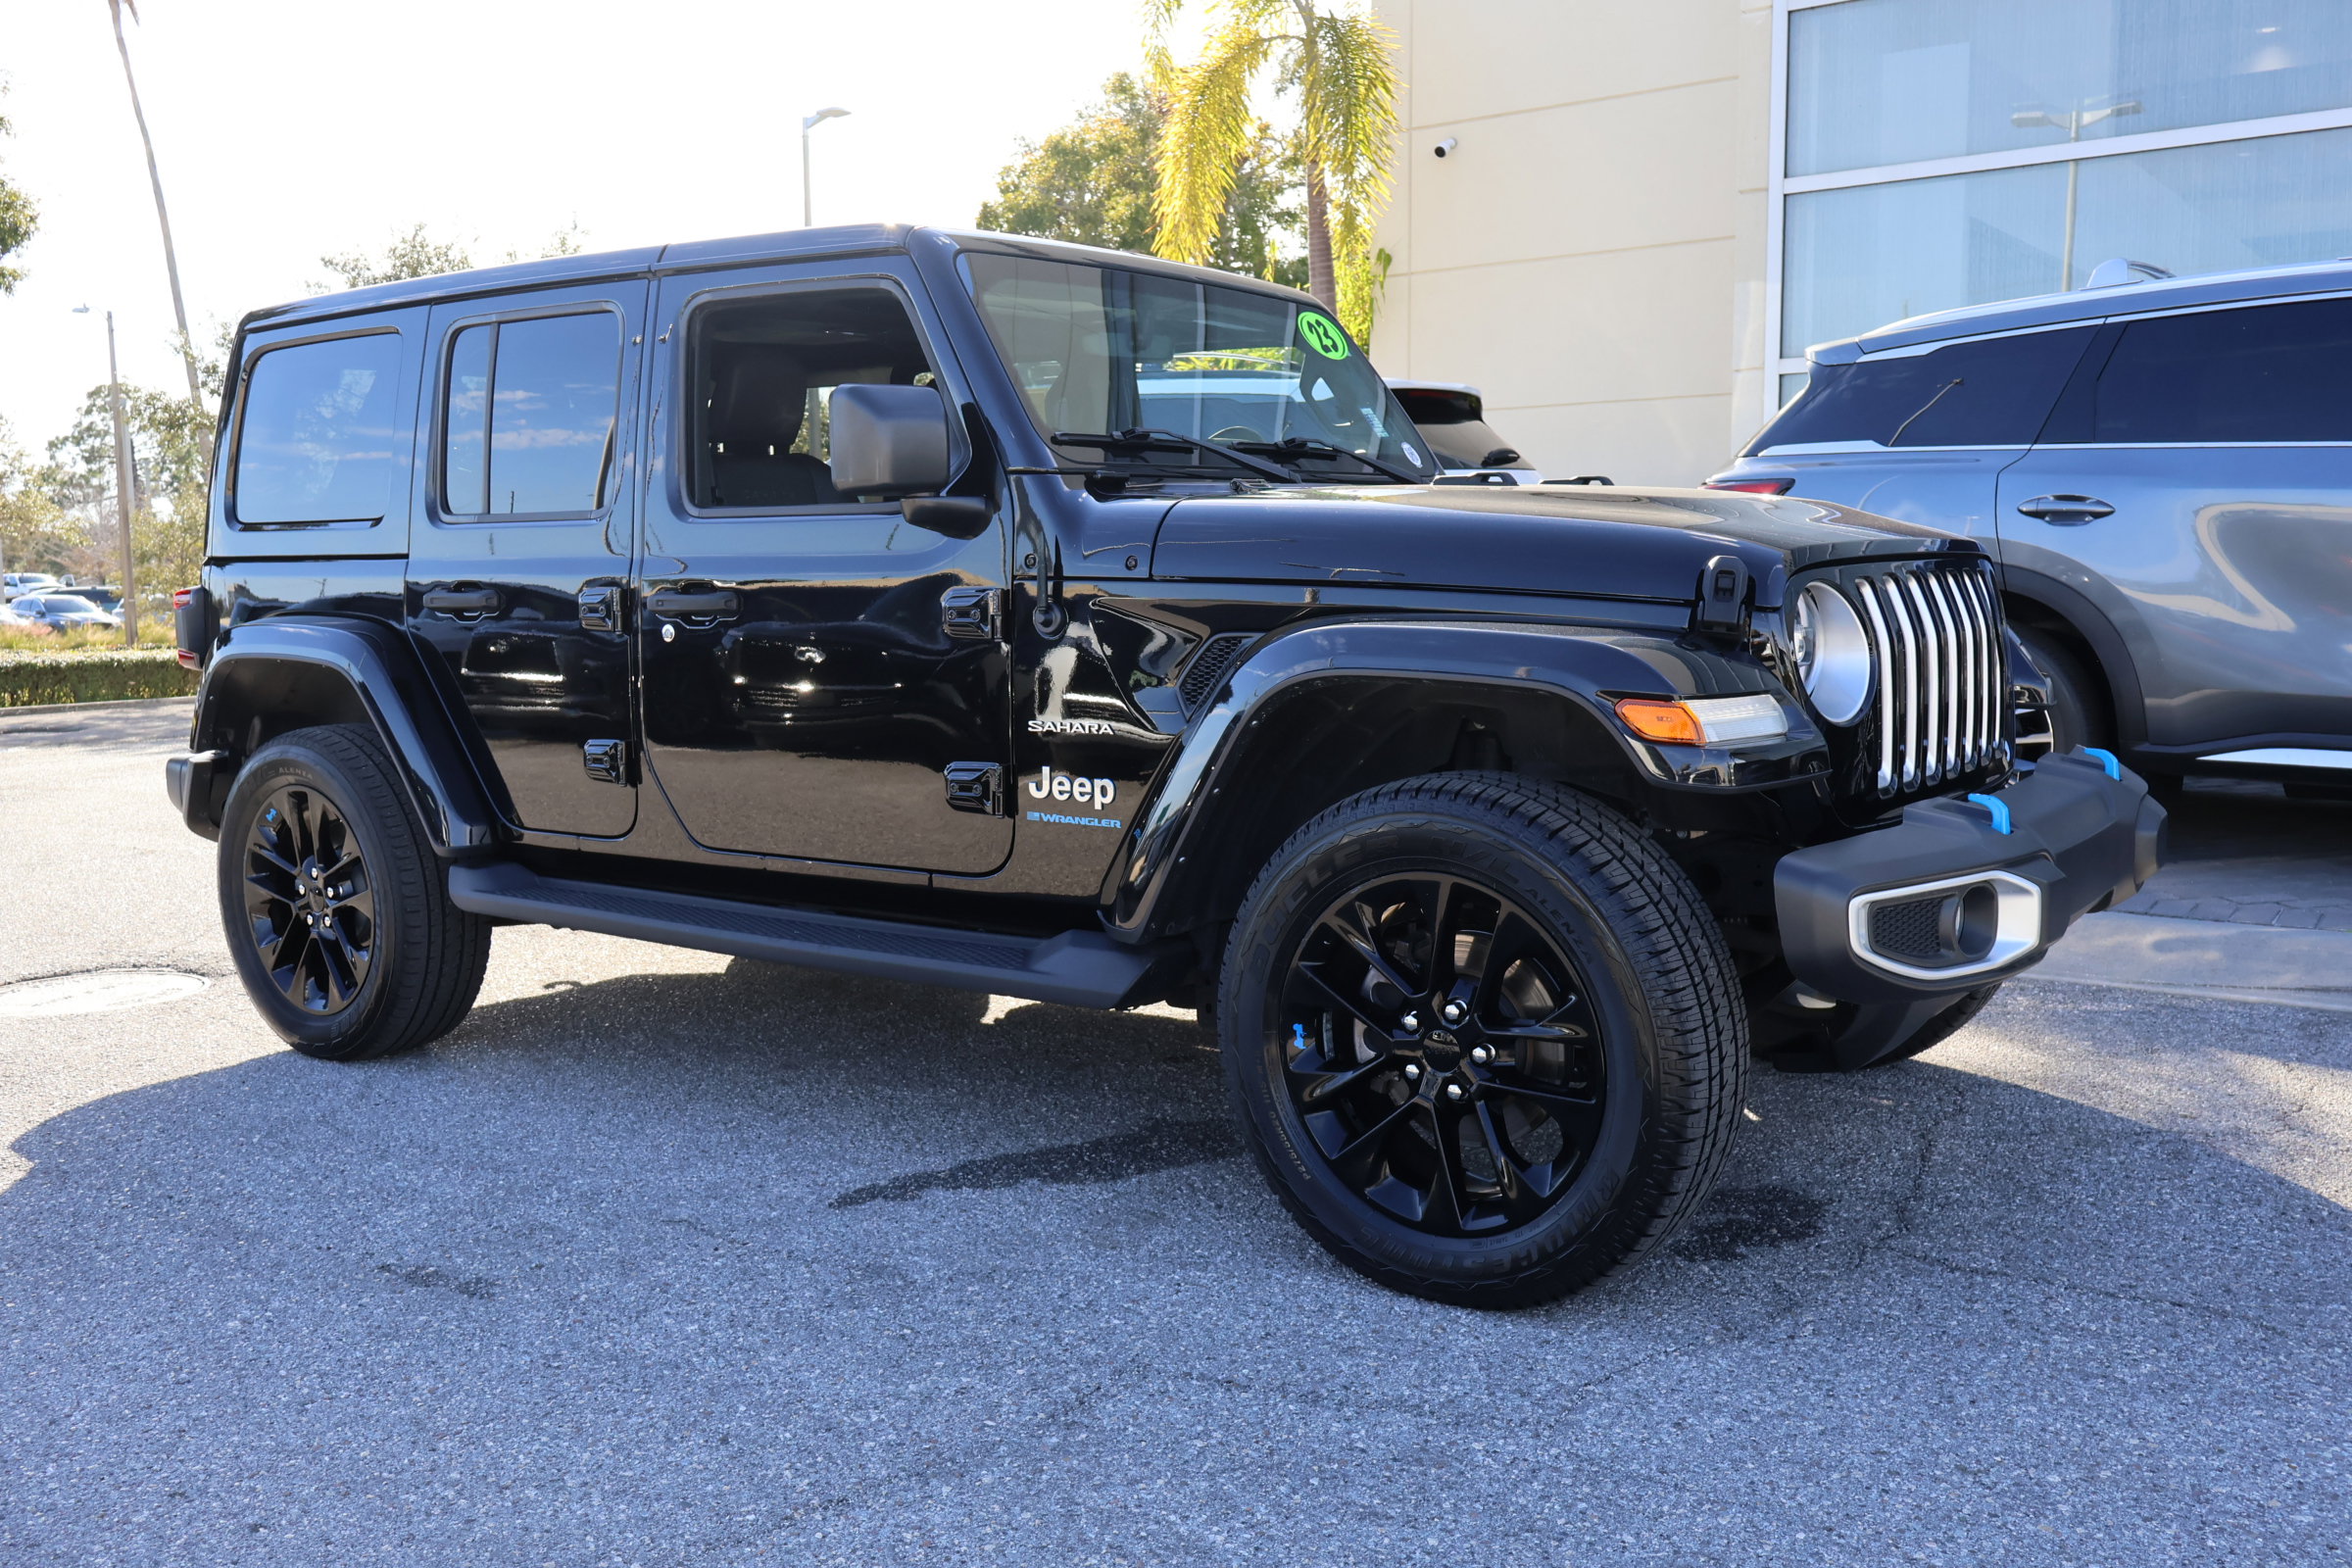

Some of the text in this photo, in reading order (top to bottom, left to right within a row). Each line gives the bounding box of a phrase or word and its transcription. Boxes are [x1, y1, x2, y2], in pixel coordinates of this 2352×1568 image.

[1028, 720, 1114, 735] SAHARA
[1029, 765, 1115, 810] Jeep
[1040, 811, 1121, 828] WRANGLER
